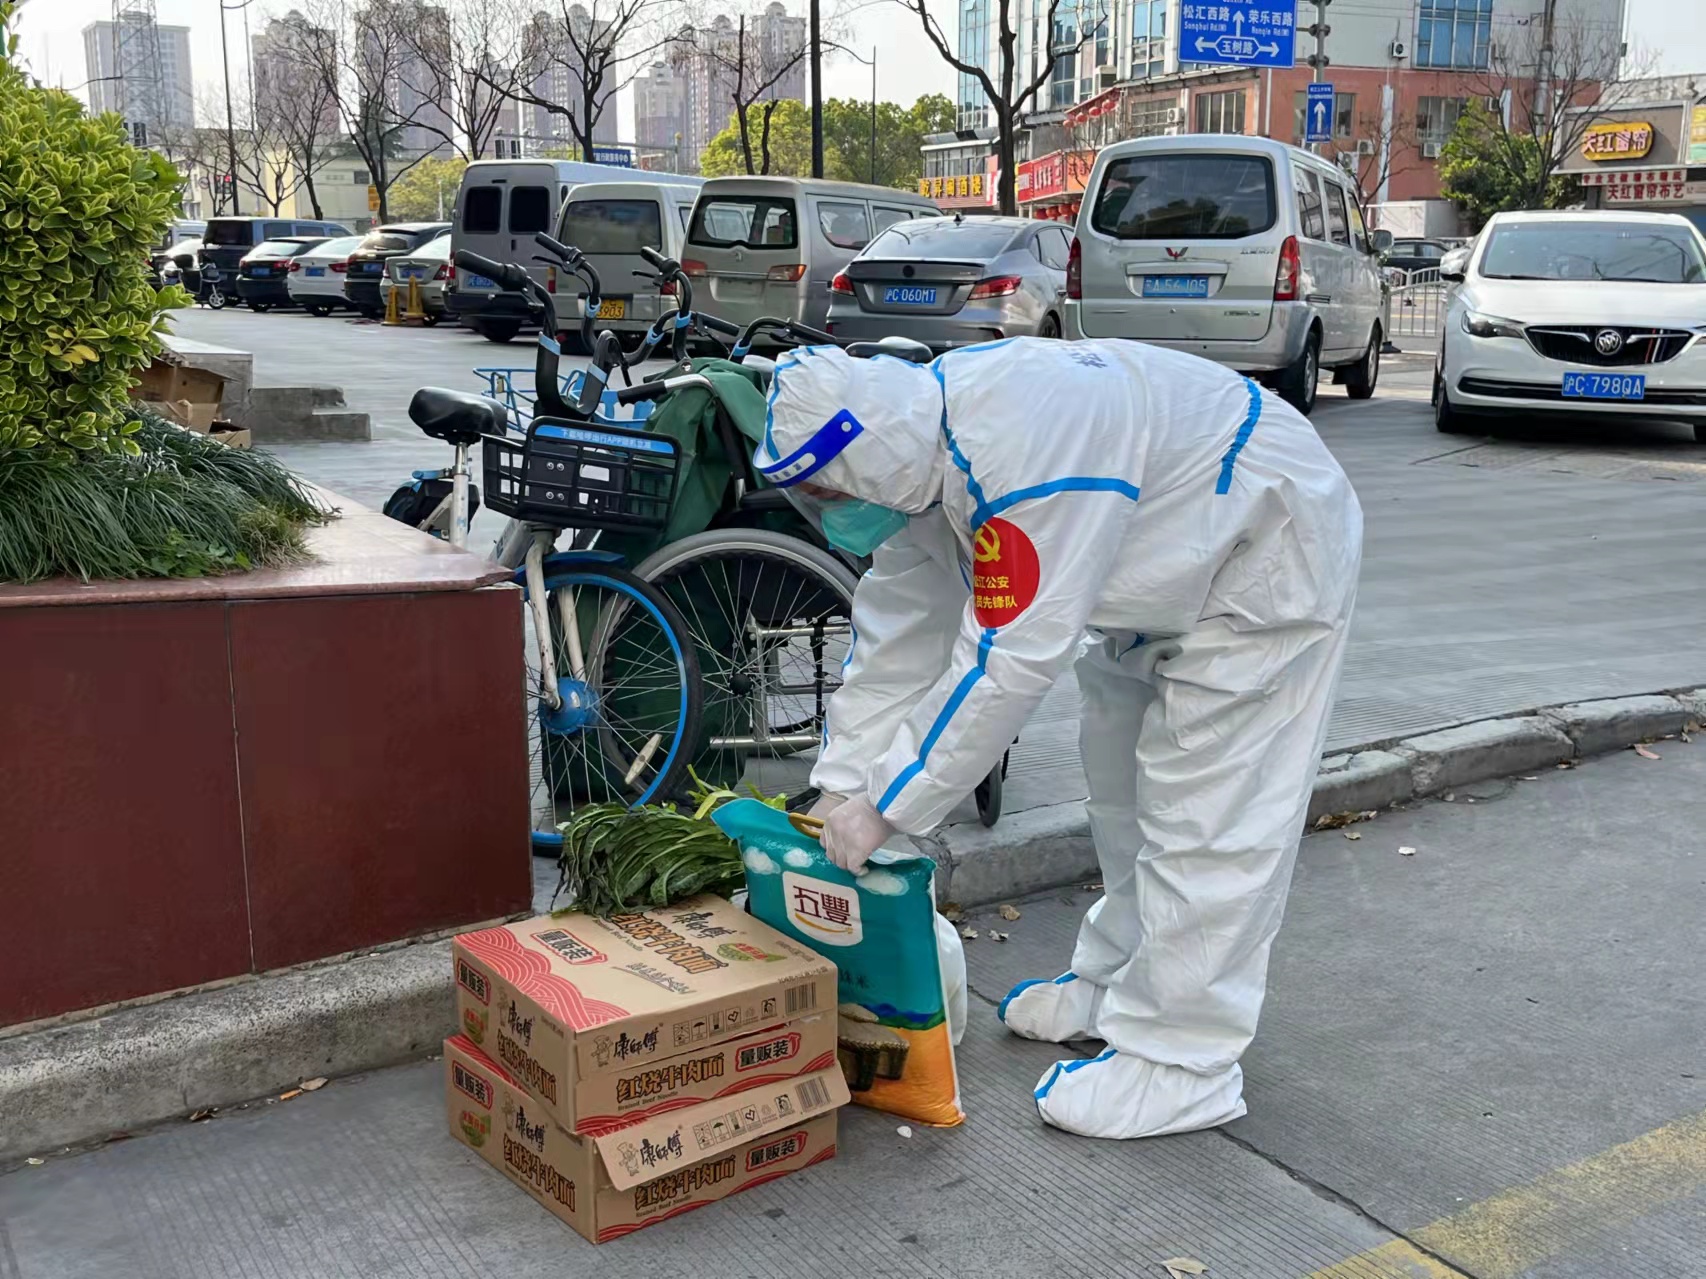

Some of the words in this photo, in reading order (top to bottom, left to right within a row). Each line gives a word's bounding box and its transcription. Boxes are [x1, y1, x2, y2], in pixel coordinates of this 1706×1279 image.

[1183, 4, 1230, 21] 松汇西路
[1248, 9, 1293, 27] 荣乐西路
[1221, 40, 1253, 55] 玉树路
[1581, 129, 1649, 153] 天红窗帘
[1607, 183, 1685, 200] 天红窗帘布艺
[536, 930, 593, 960] 量贩装
[611, 912, 729, 974] 红烧牛肉面
[460, 960, 485, 999] 量贩装
[497, 1028, 557, 1106] 红烧牛肉面
[740, 1039, 789, 1068] 量贩装
[455, 1065, 486, 1103] 量贩装
[615, 1052, 725, 1104] 红烧牛肉面
[750, 1139, 796, 1167] 量贩装
[503, 1133, 576, 1212] 红烧牛肉面
[634, 1155, 736, 1212] 红烧牛肉面
